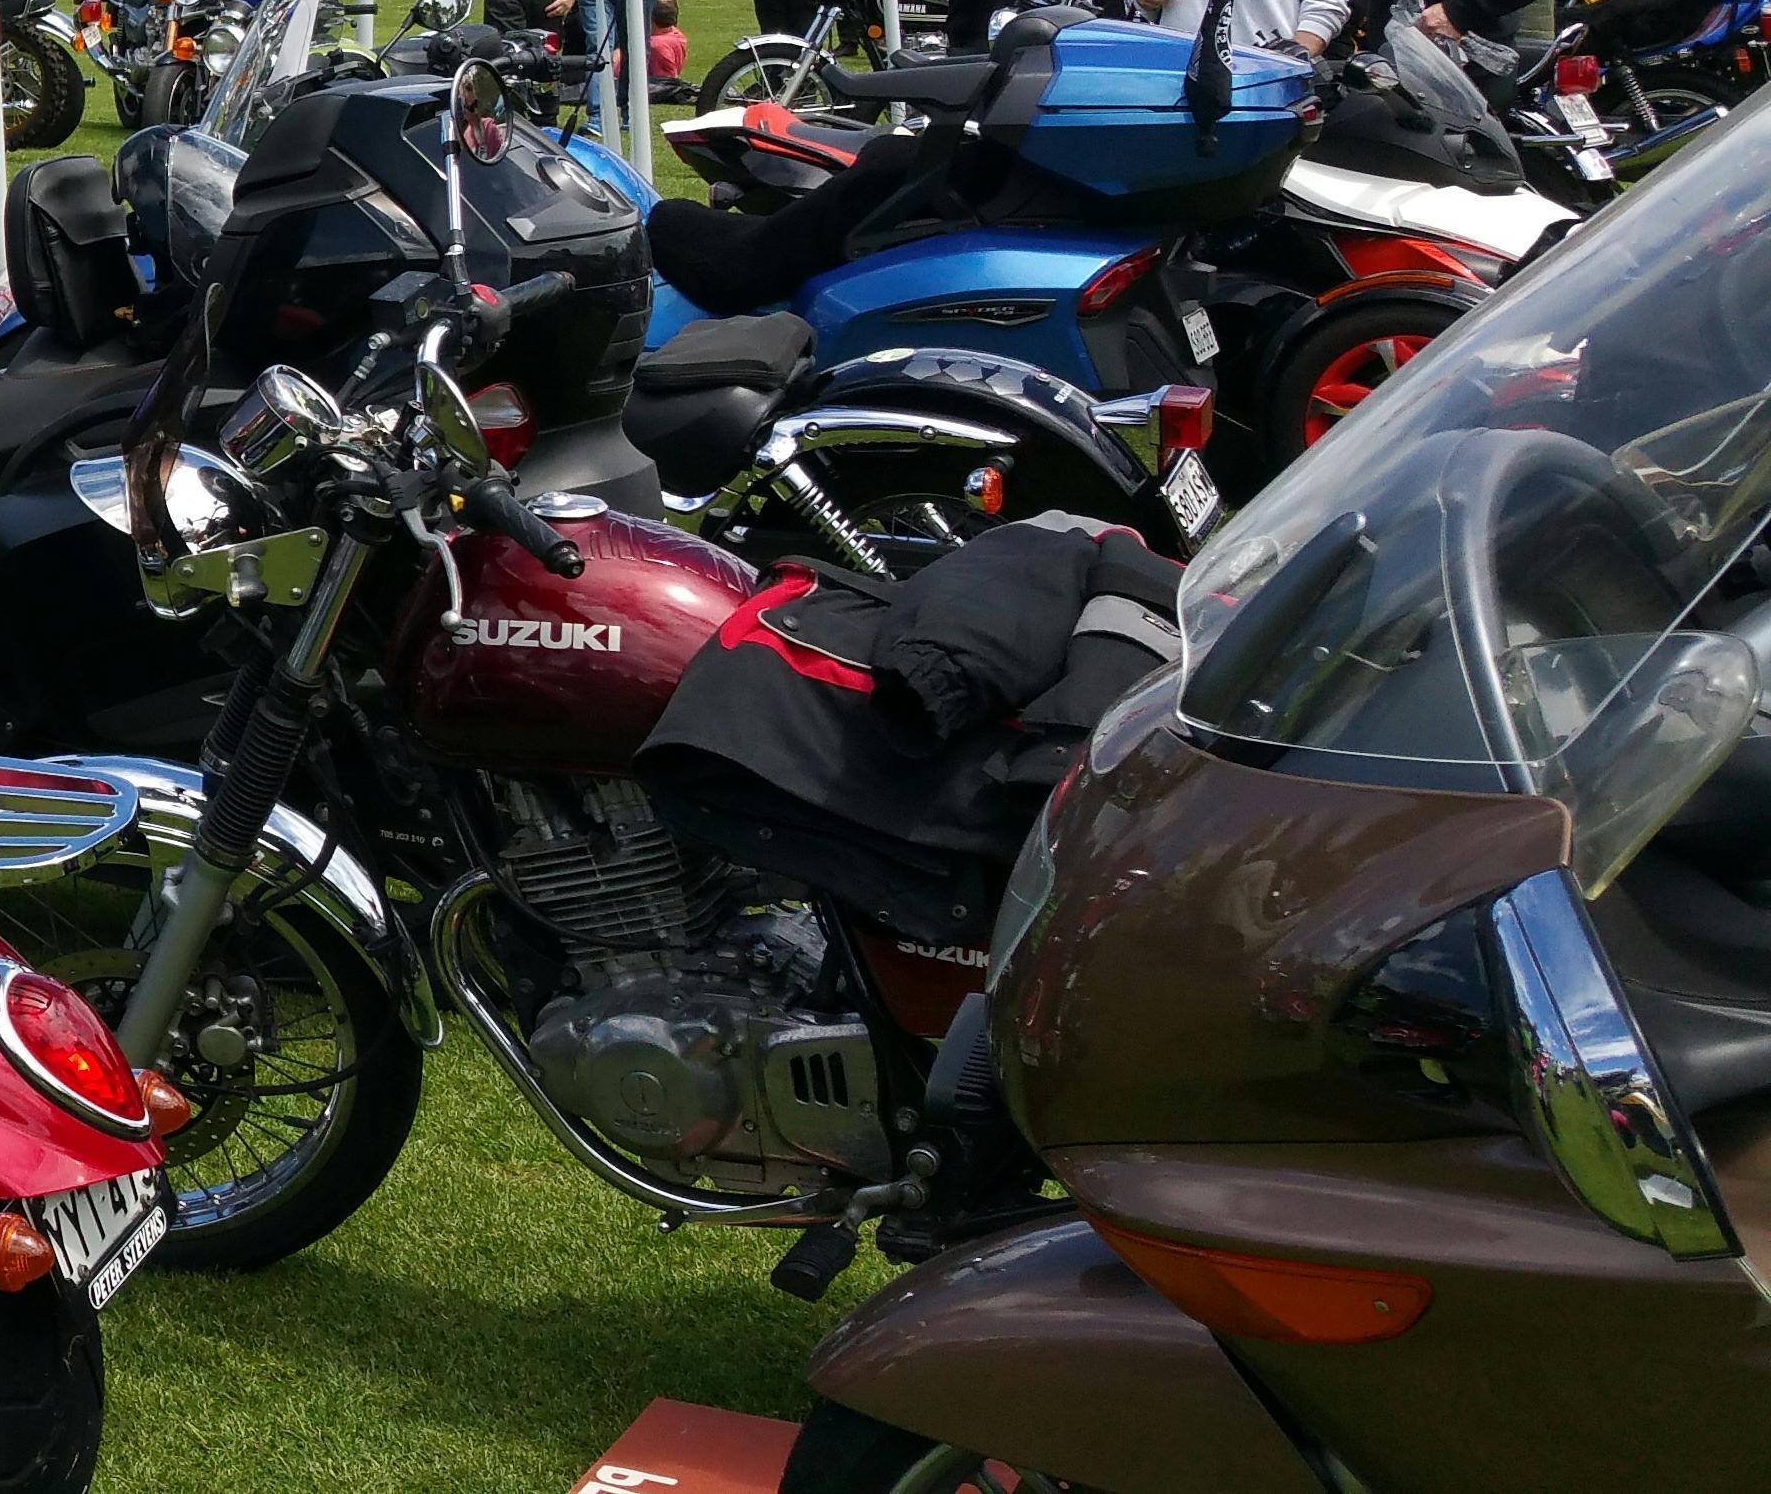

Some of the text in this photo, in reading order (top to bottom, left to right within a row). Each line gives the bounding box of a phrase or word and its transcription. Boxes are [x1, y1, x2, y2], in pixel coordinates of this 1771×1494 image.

[451, 618, 621, 652] SUZUKI
[896, 938, 991, 969] SUZUK
[92, 1211, 165, 1306] PETER STEVENS
